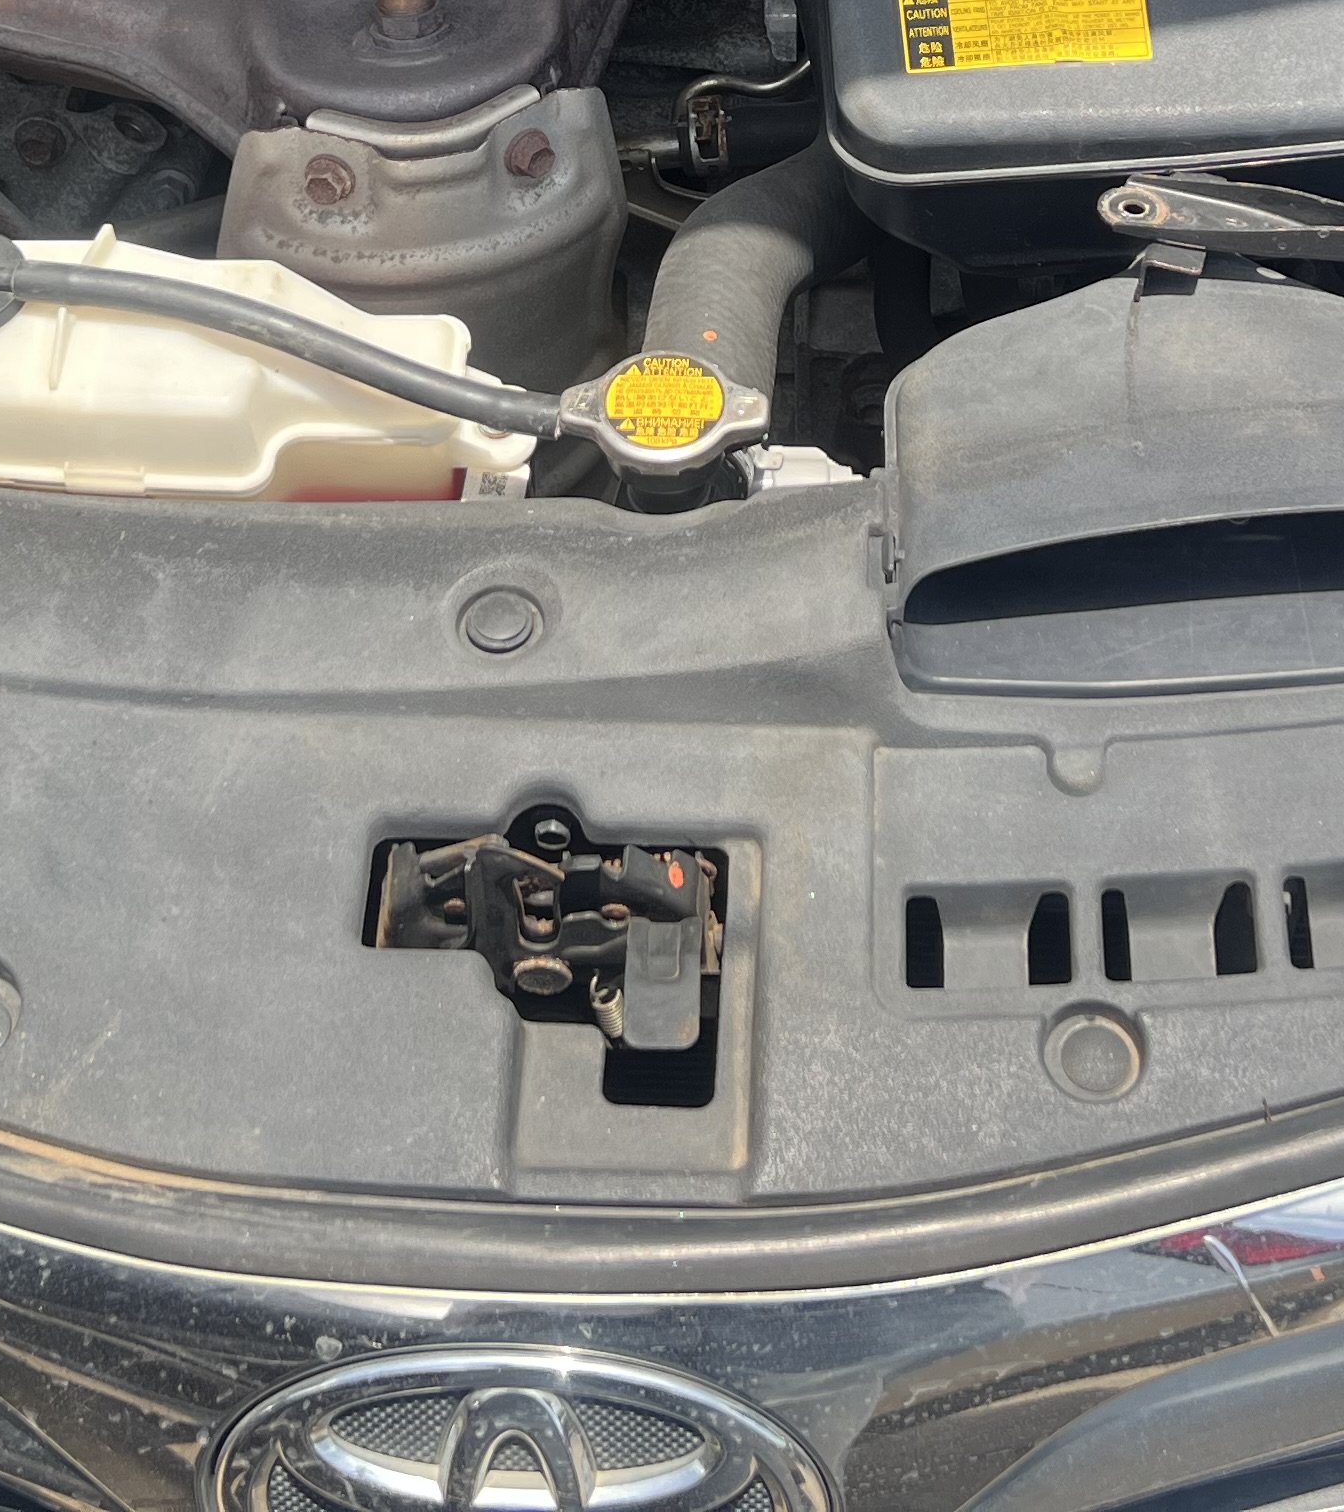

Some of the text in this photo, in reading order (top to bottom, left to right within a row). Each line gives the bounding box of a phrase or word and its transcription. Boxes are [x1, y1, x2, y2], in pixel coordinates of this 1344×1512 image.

[906, 7, 948, 20] CAUTION
[908, 26, 950, 38] ATTENTION
[643, 357, 690, 368] CAUTION
[643, 367, 703, 376] ATTENTION
[636, 417, 705, 429] ВНИМАНИЕ!
